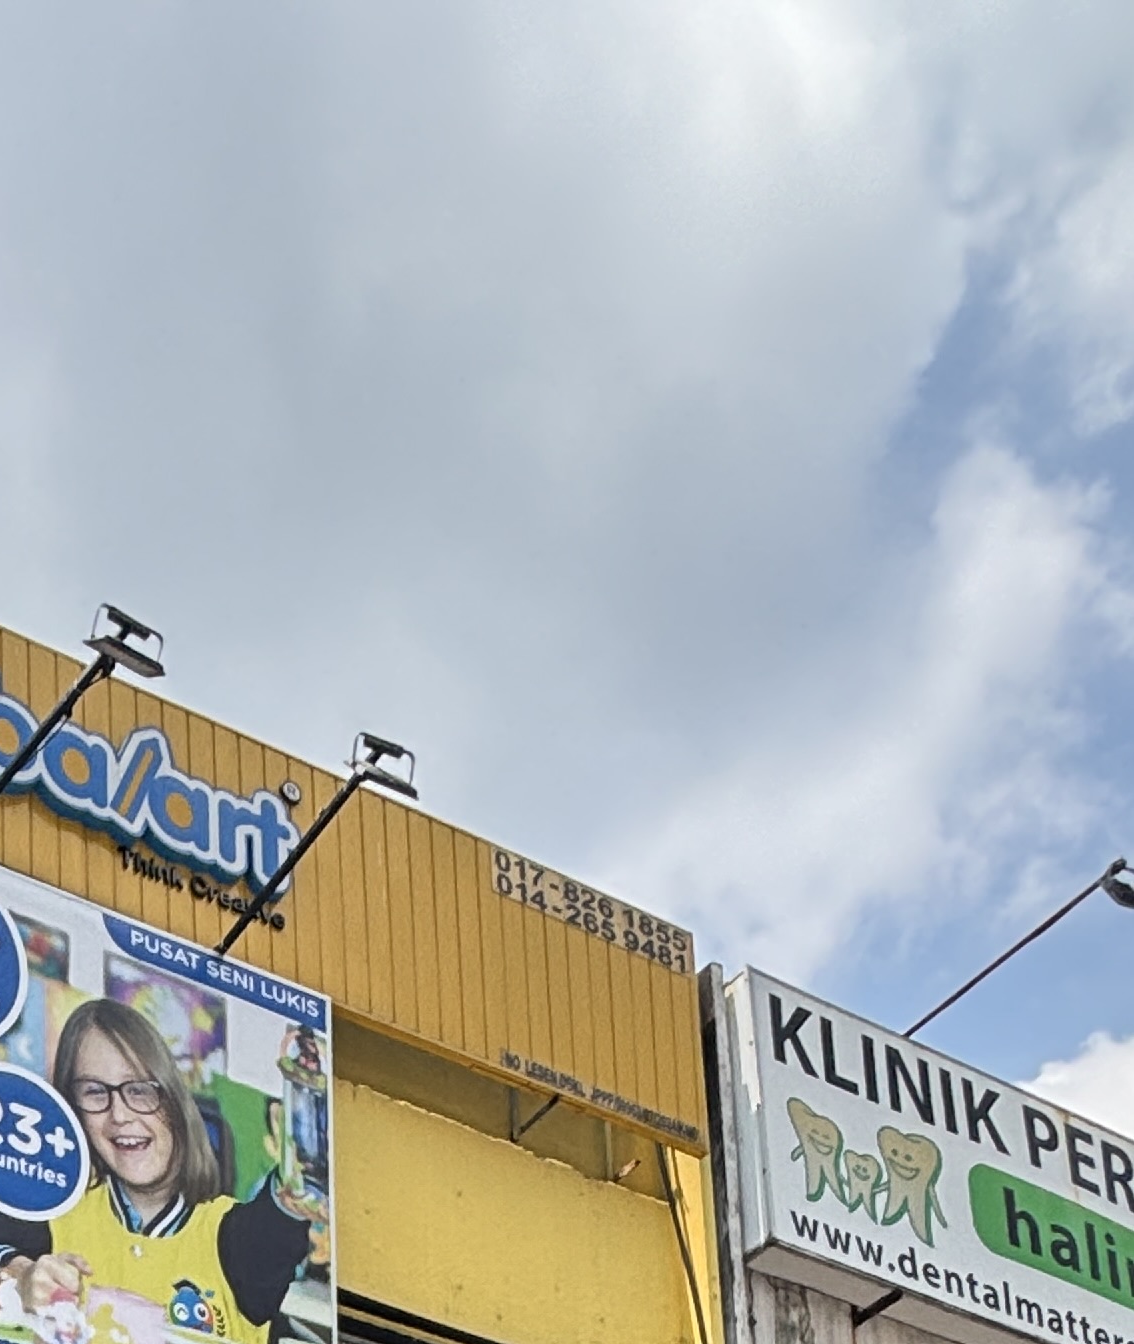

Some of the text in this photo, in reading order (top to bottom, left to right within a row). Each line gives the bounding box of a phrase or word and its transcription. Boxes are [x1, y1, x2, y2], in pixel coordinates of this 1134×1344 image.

[118, 845, 184, 892] Think
[129, 929, 320, 1018] PUSAT SENI LUKIS
[622, 929, 686, 974] 9481
[768, 993, 1011, 1156] KLINIK
[1002, 1187, 1134, 1297] hali
